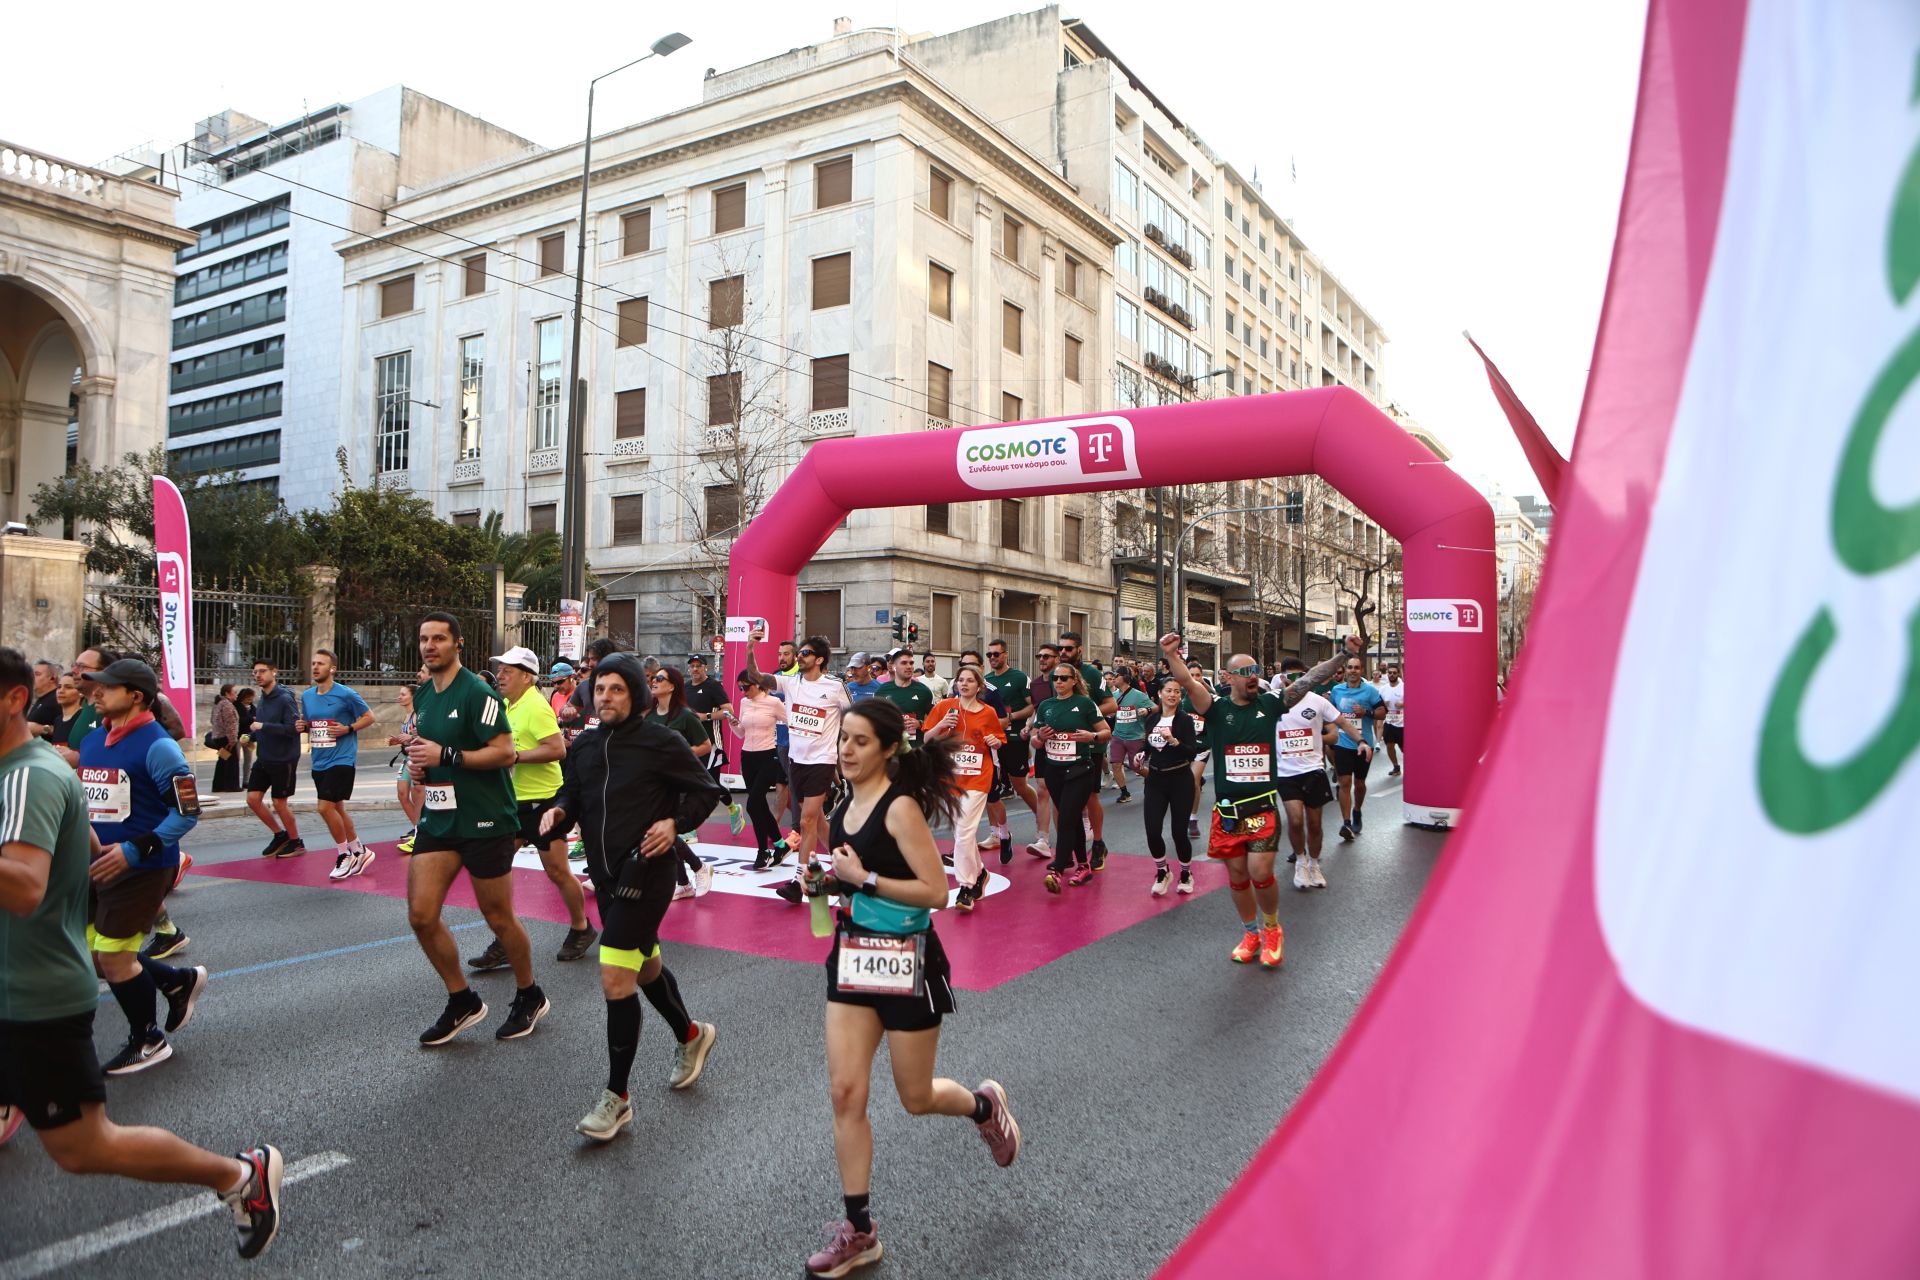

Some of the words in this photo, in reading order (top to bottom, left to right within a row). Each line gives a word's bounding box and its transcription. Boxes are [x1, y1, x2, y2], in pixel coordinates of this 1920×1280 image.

[966, 437, 1067, 463] COSMOTE
[1088, 432, 1113, 463] T
[968, 464, 1010, 474] Συνδέουμε
[1025, 460, 1049, 470] κόσμο
[1050, 459, 1067, 467] σου.
[1408, 612, 1453, 620] COSMOTE
[798, 705, 819, 716] ERGO
[311, 720, 328, 728] ERGO
[588, 717, 601, 726] ERG
[794, 715, 819, 727] 14609
[1149, 735, 1166, 743] 146
[1285, 730, 1305, 738] ERGO
[1048, 742, 1071, 750] 12757
[1285, 738, 1309, 748] 15272
[1234, 745, 1260, 754] ERGO
[1231, 757, 1264, 768] 15156
[82, 769, 109, 782] ERGO
[853, 955, 913, 976] 14003
